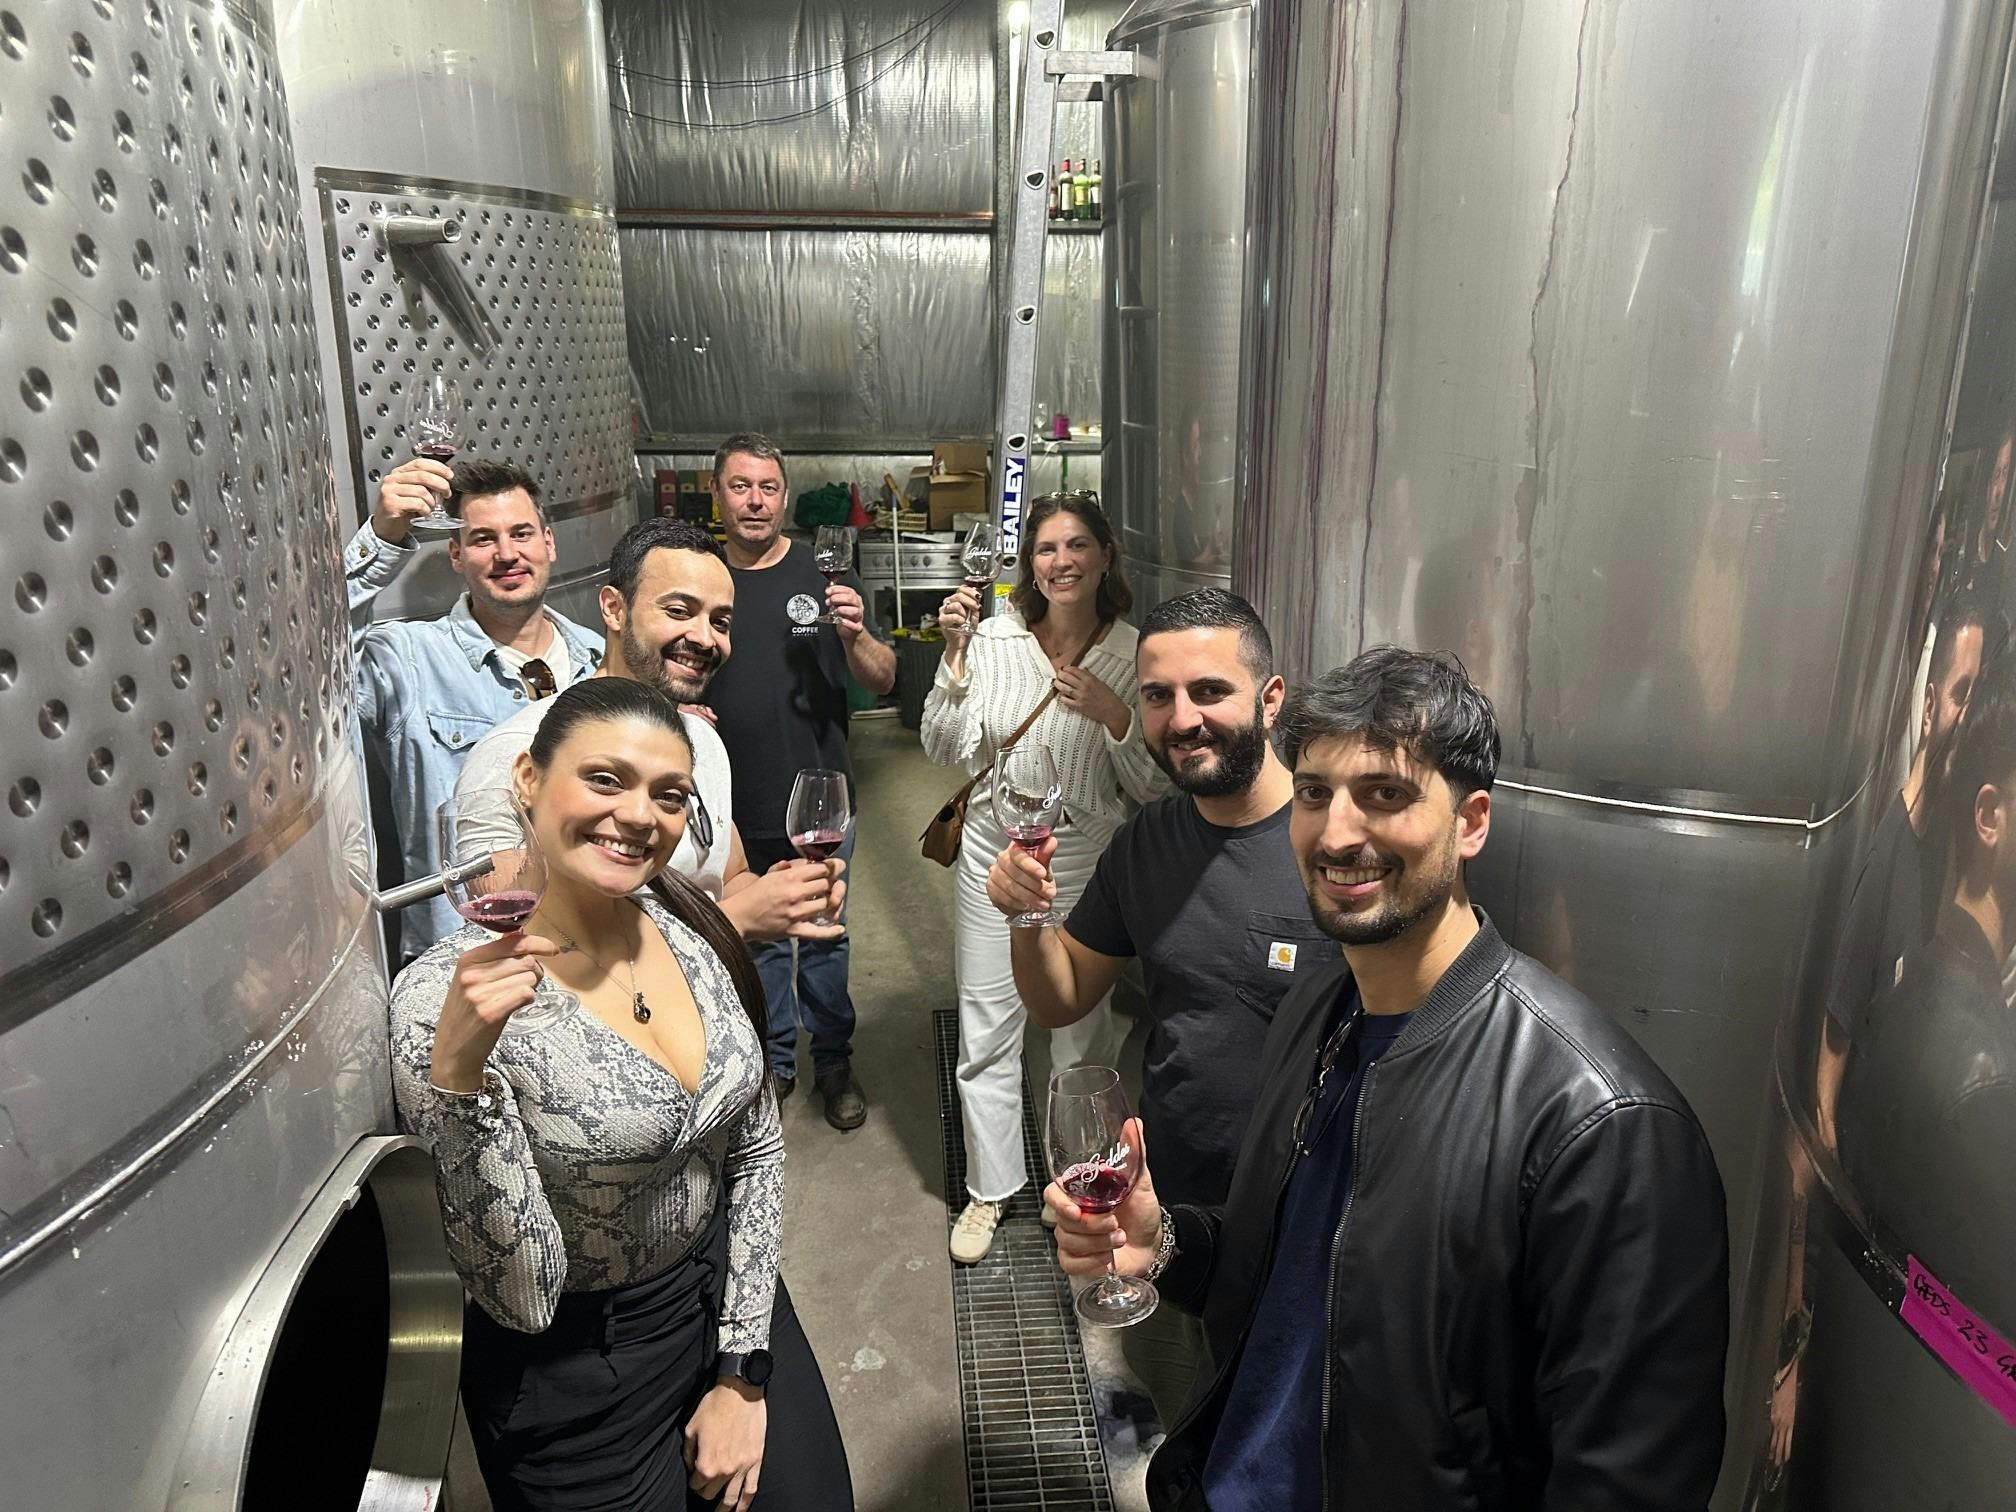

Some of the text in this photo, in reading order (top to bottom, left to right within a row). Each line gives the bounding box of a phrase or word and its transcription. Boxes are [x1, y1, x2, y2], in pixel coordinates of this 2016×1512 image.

[1003, 457, 1025, 554] BAILEY
[791, 626, 819, 634] COFFEE
[1957, 1319, 1989, 1355] 23
